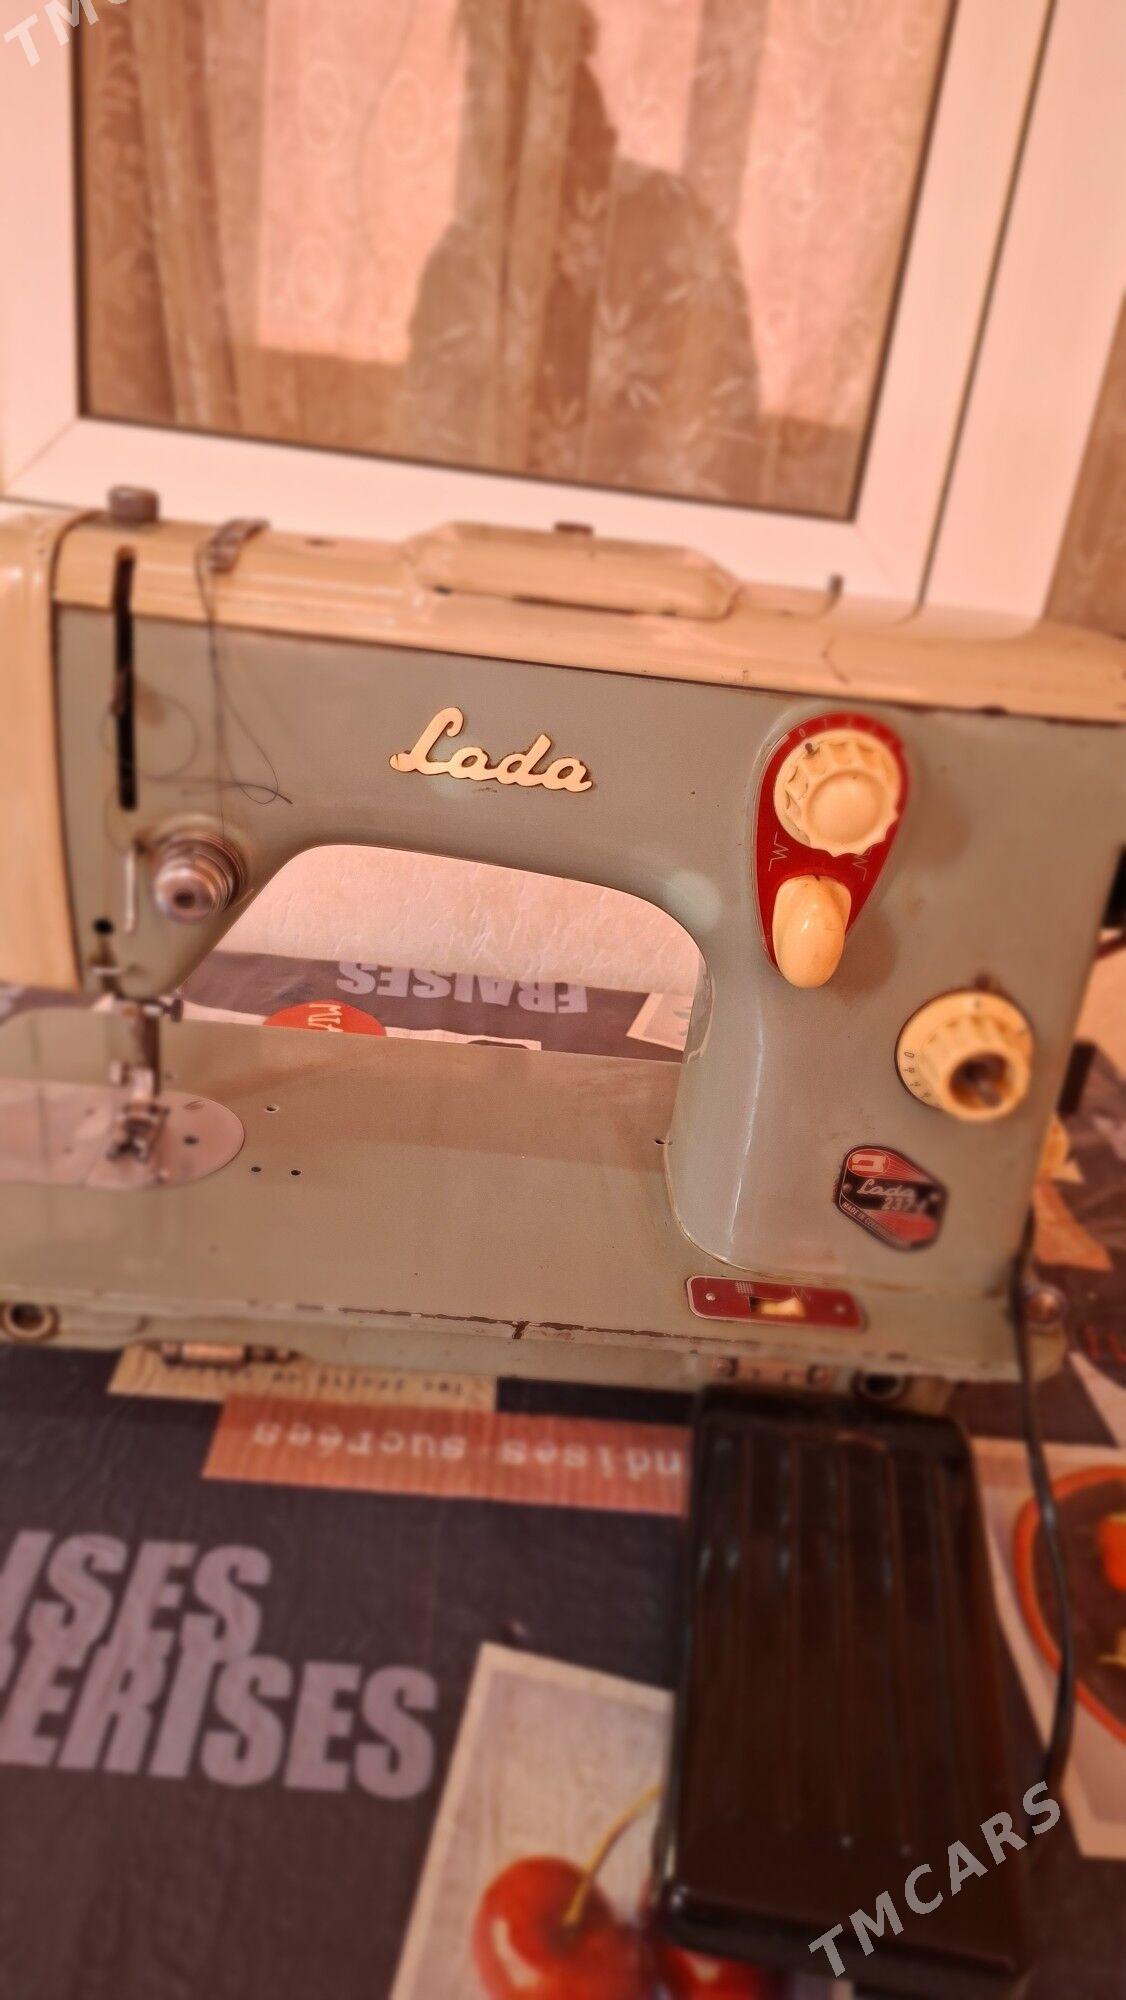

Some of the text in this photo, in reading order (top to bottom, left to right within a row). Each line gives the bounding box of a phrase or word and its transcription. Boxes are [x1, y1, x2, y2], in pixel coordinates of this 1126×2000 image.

[389, 706, 593, 793] Lada
[336, 961, 589, 1014] FRAISES
[856, 1178, 916, 1197] Lada
